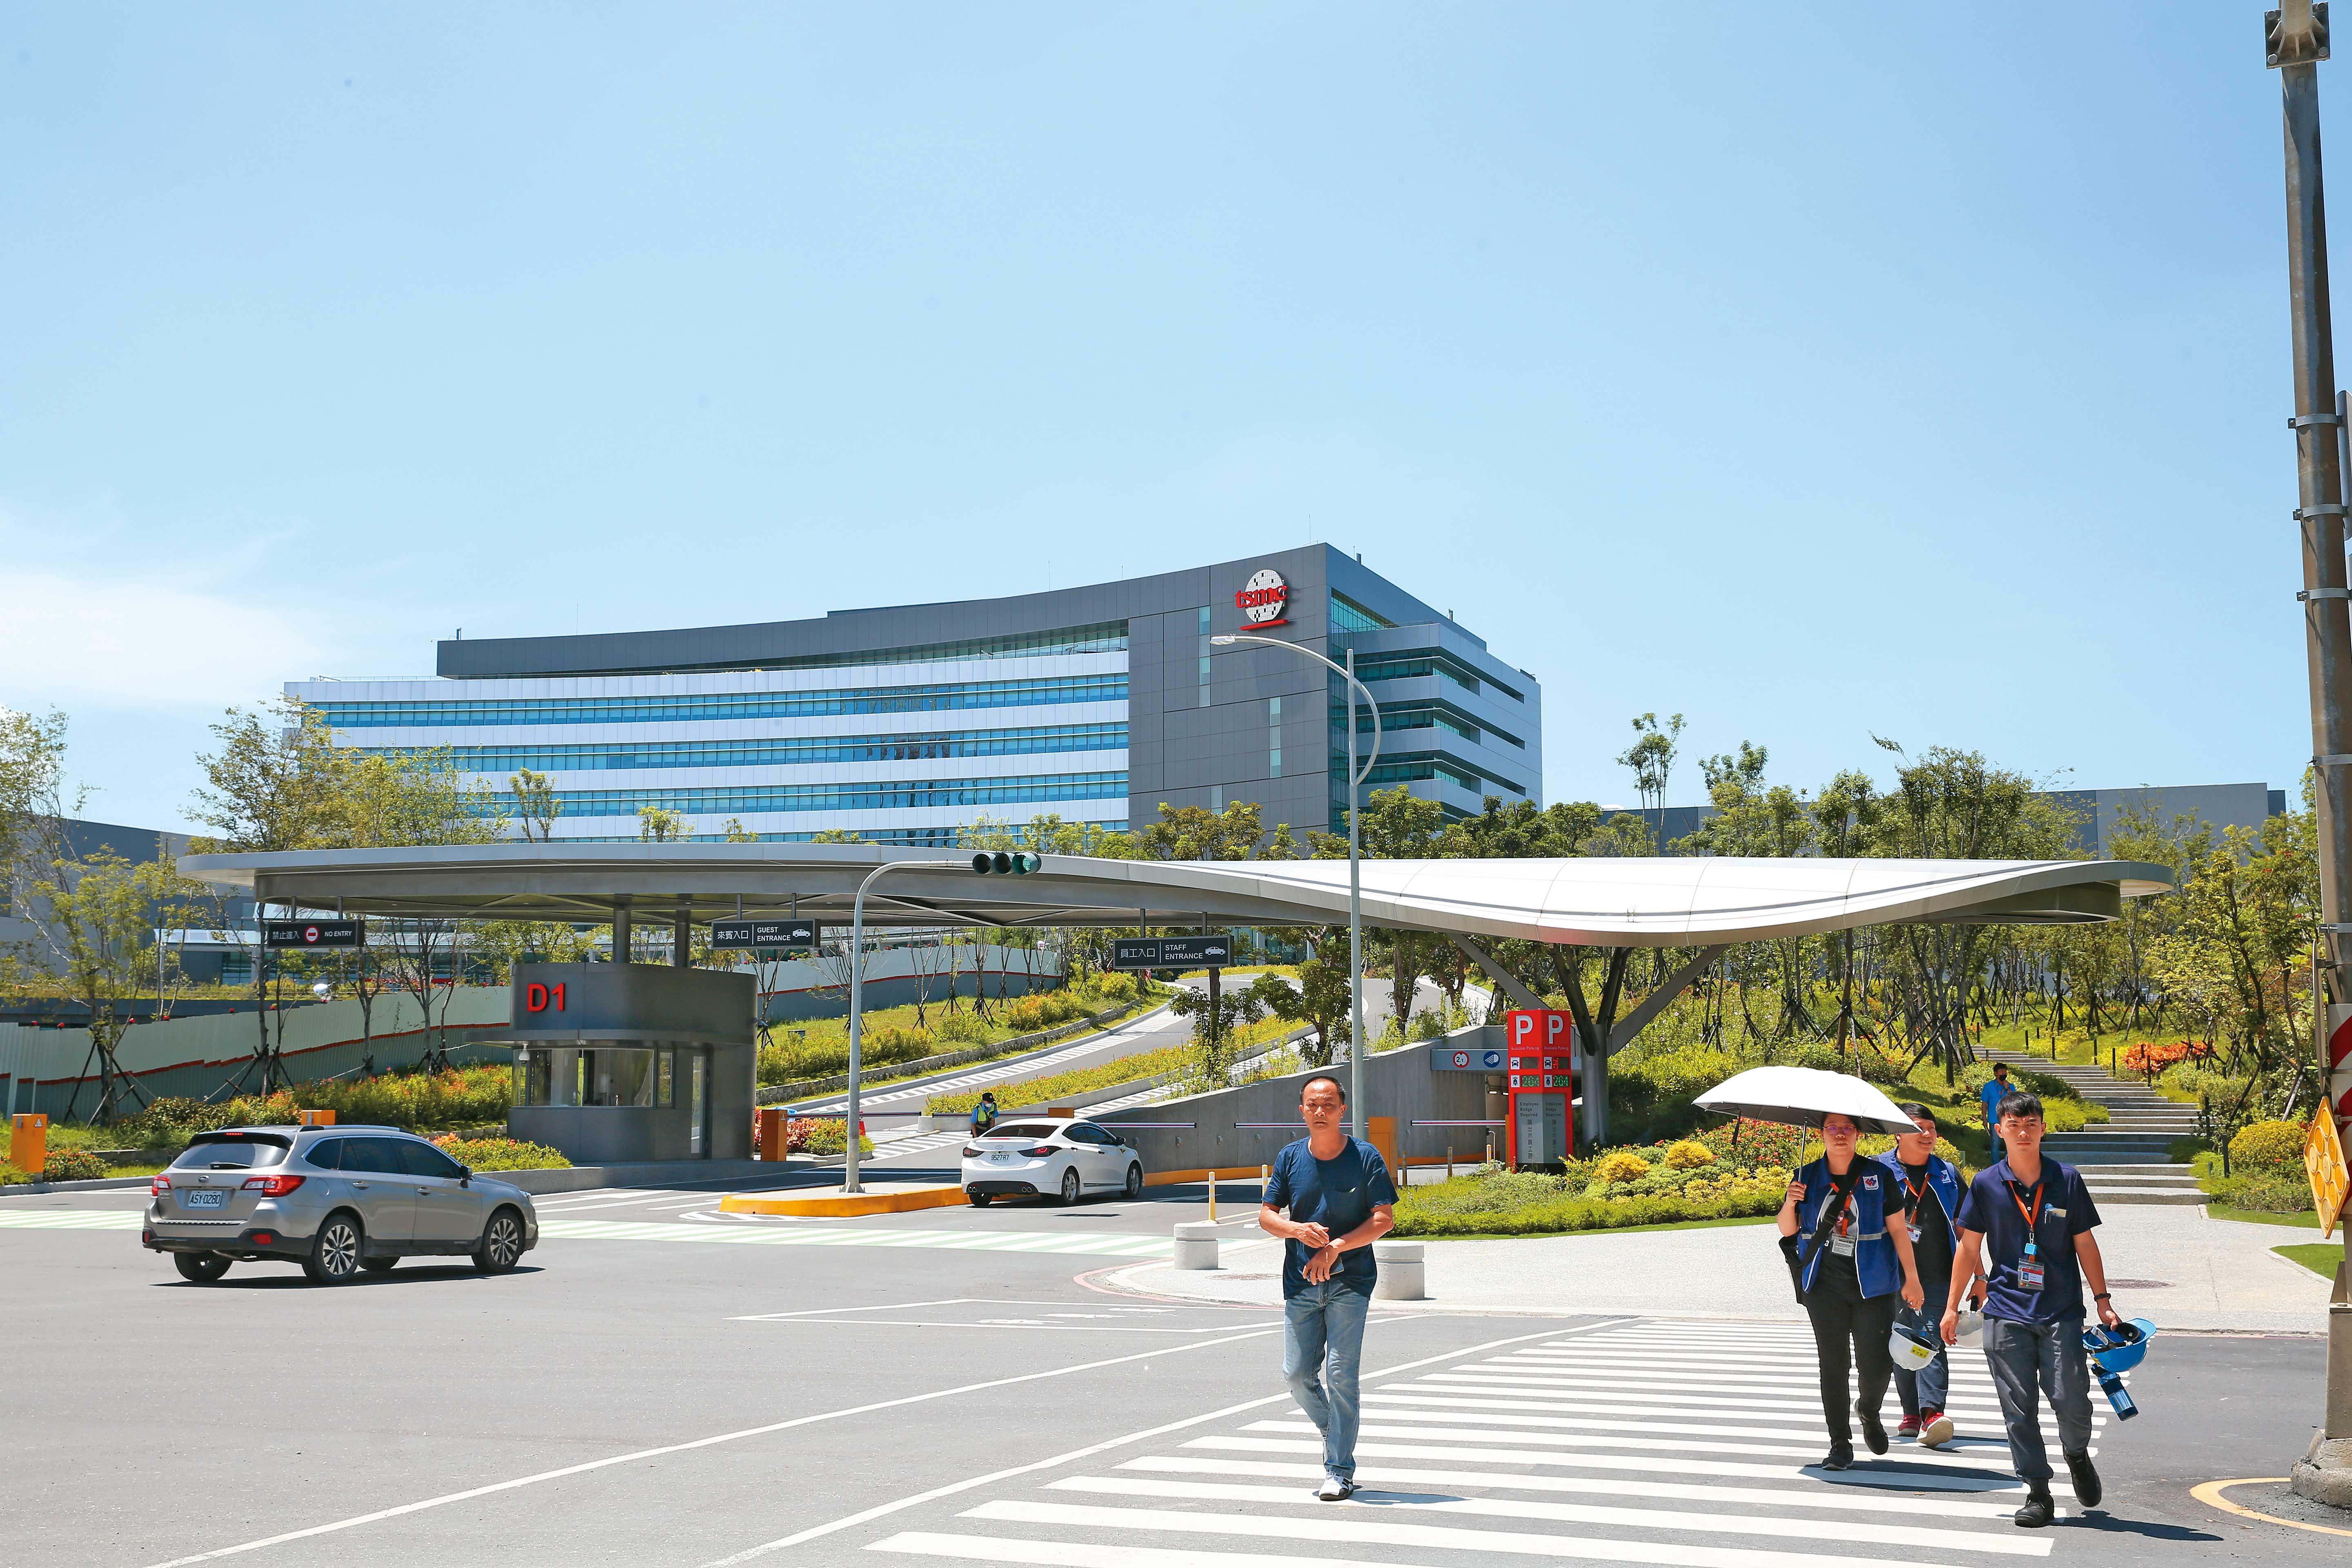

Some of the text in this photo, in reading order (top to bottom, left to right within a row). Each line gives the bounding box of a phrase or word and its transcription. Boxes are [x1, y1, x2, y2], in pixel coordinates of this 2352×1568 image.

[1234, 585, 1288, 608] tsmc
[272, 931, 300, 940] 禁止進入
[717, 930, 748, 940] 來賓入口
[1120, 948, 1155, 958] 員工入口
[527, 982, 565, 1012] D1
[1516, 1015, 1533, 1045] P
[1548, 1015, 1564, 1044] P
[1522, 1076, 1539, 1087] 264
[1553, 1076, 1568, 1086] 264
[189, 1194, 220, 1204] ASY-0280
